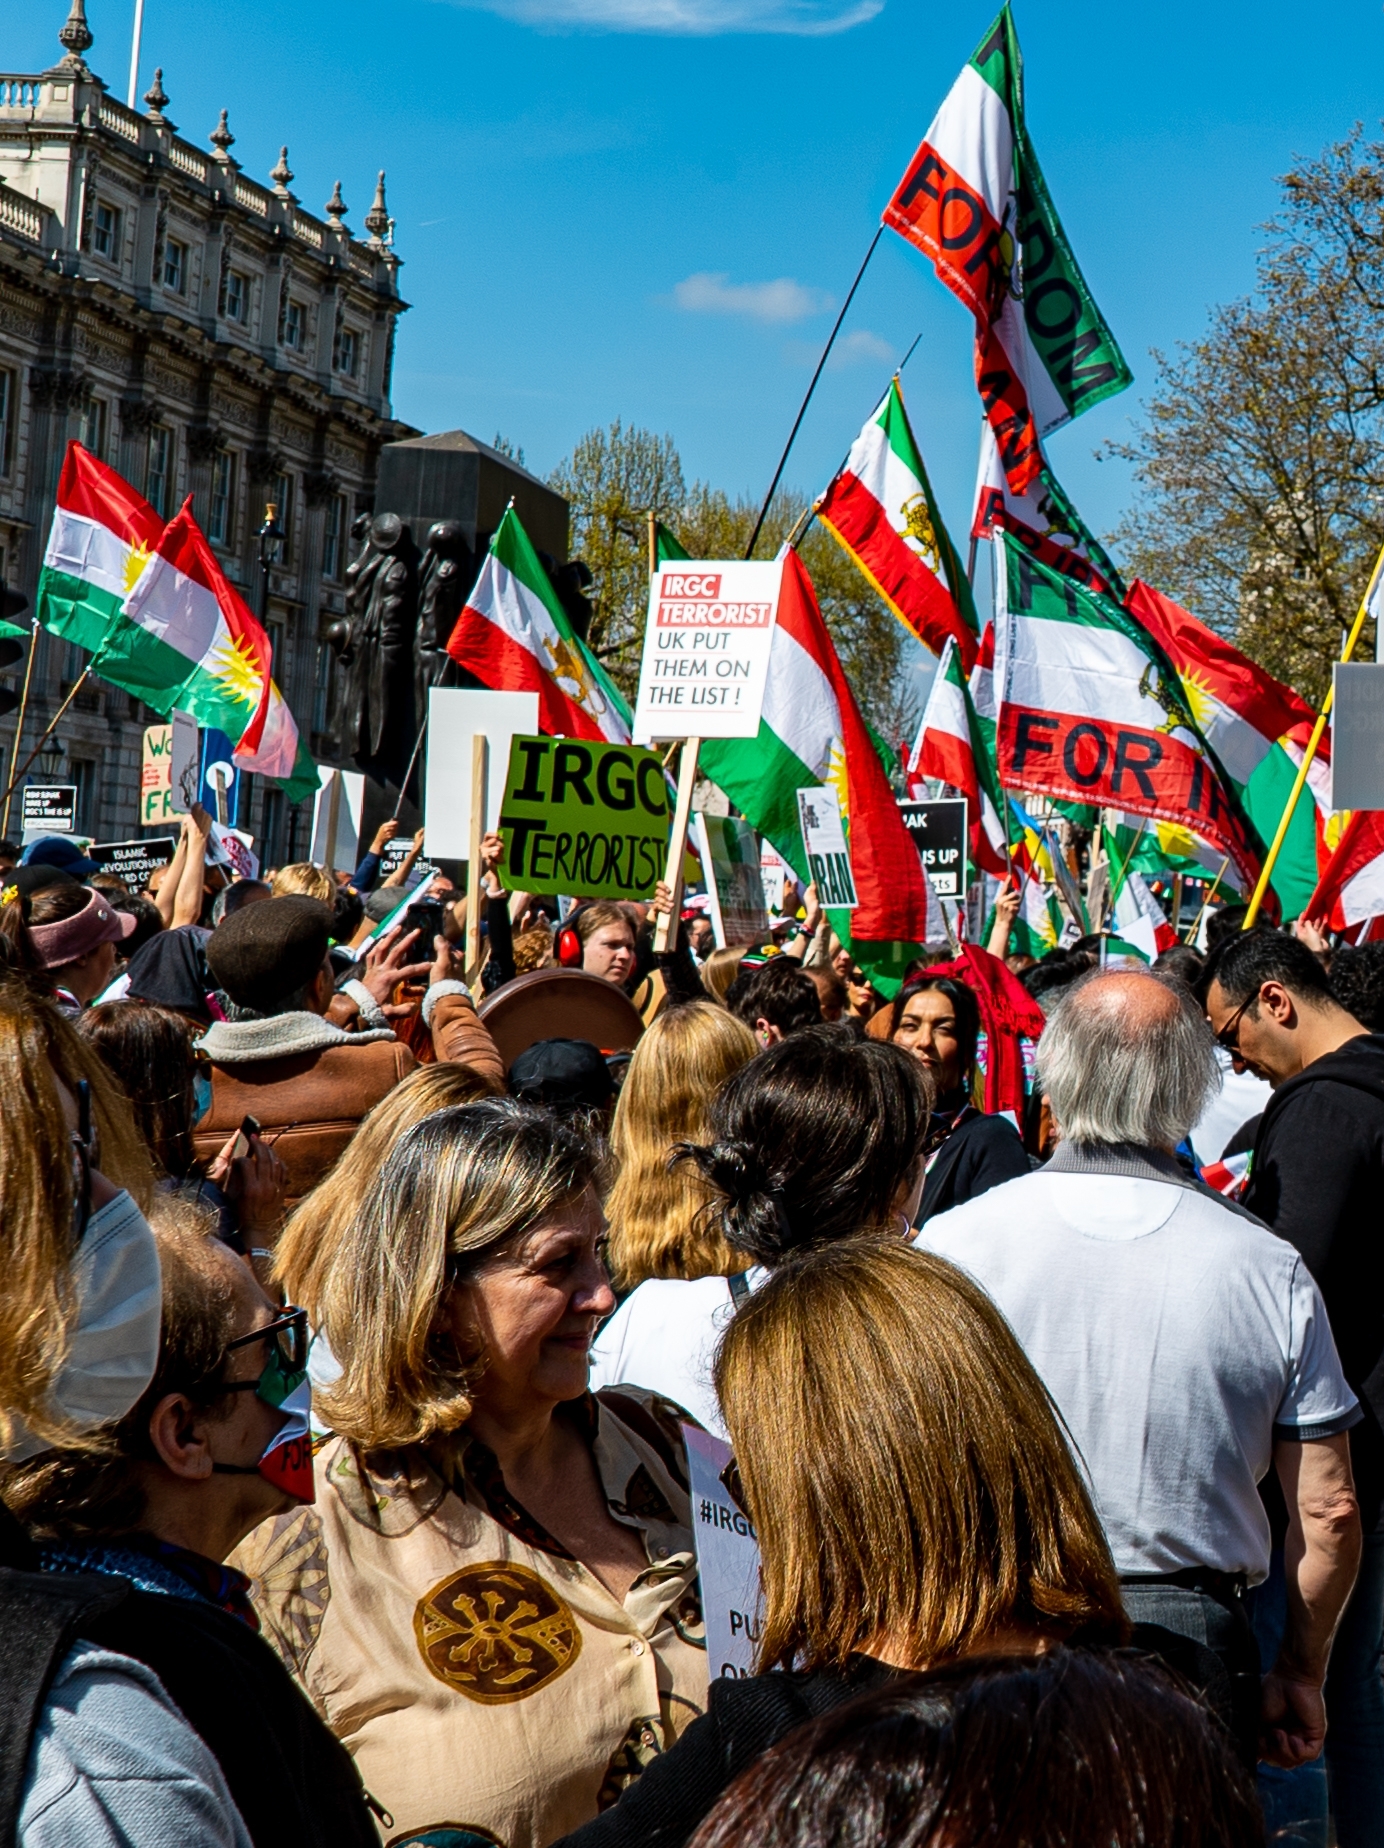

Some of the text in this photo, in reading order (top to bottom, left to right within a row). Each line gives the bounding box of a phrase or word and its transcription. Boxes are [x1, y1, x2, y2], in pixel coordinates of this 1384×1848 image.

[663, 575, 717, 597] IRGC
[661, 603, 770, 624] TERRORIST
[657, 632, 732, 650] UK PUT
[653, 658, 751, 678] THEM ON
[649, 686, 741, 706] THE LIST !
[1010, 712, 1165, 802] FOR
[512, 740, 668, 817] IRGC
[113, 847, 147, 860] ISLAMIC
[499, 816, 669, 891] TERRORIST
[922, 849, 959, 865] IS UP
[729, 1609, 763, 1643] PU
